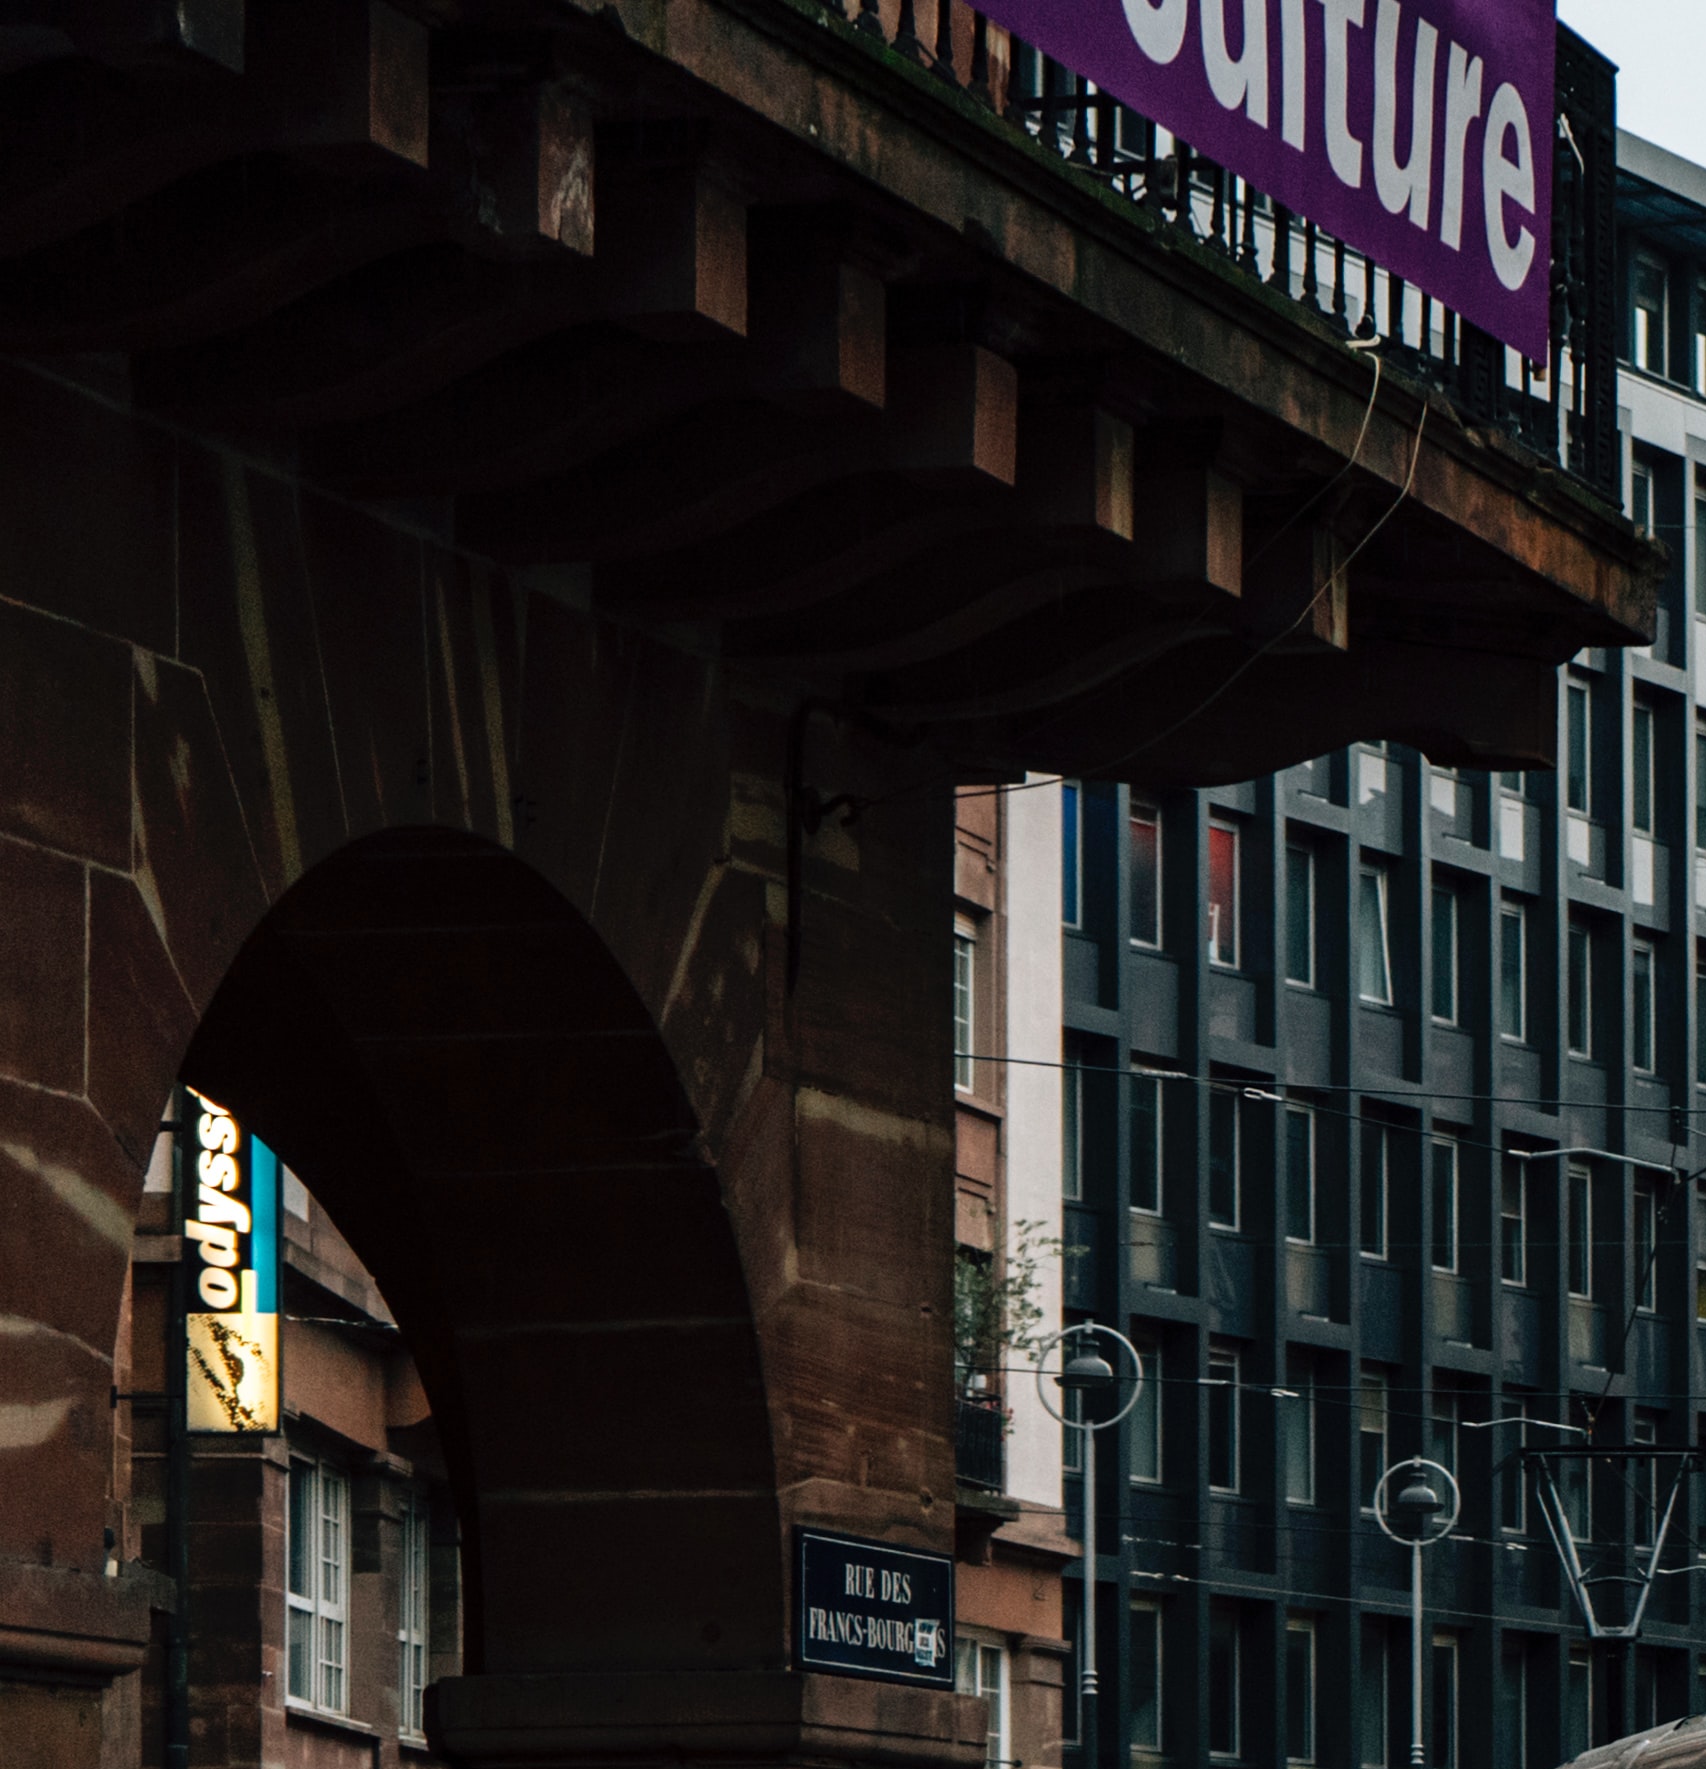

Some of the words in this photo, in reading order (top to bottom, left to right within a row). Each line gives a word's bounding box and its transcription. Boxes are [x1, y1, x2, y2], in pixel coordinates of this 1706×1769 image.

[845, 1562, 875, 1600] RUE
[880, 1568, 912, 1605] DES
[808, 1606, 946, 1658] FRANCS-BOURGS
